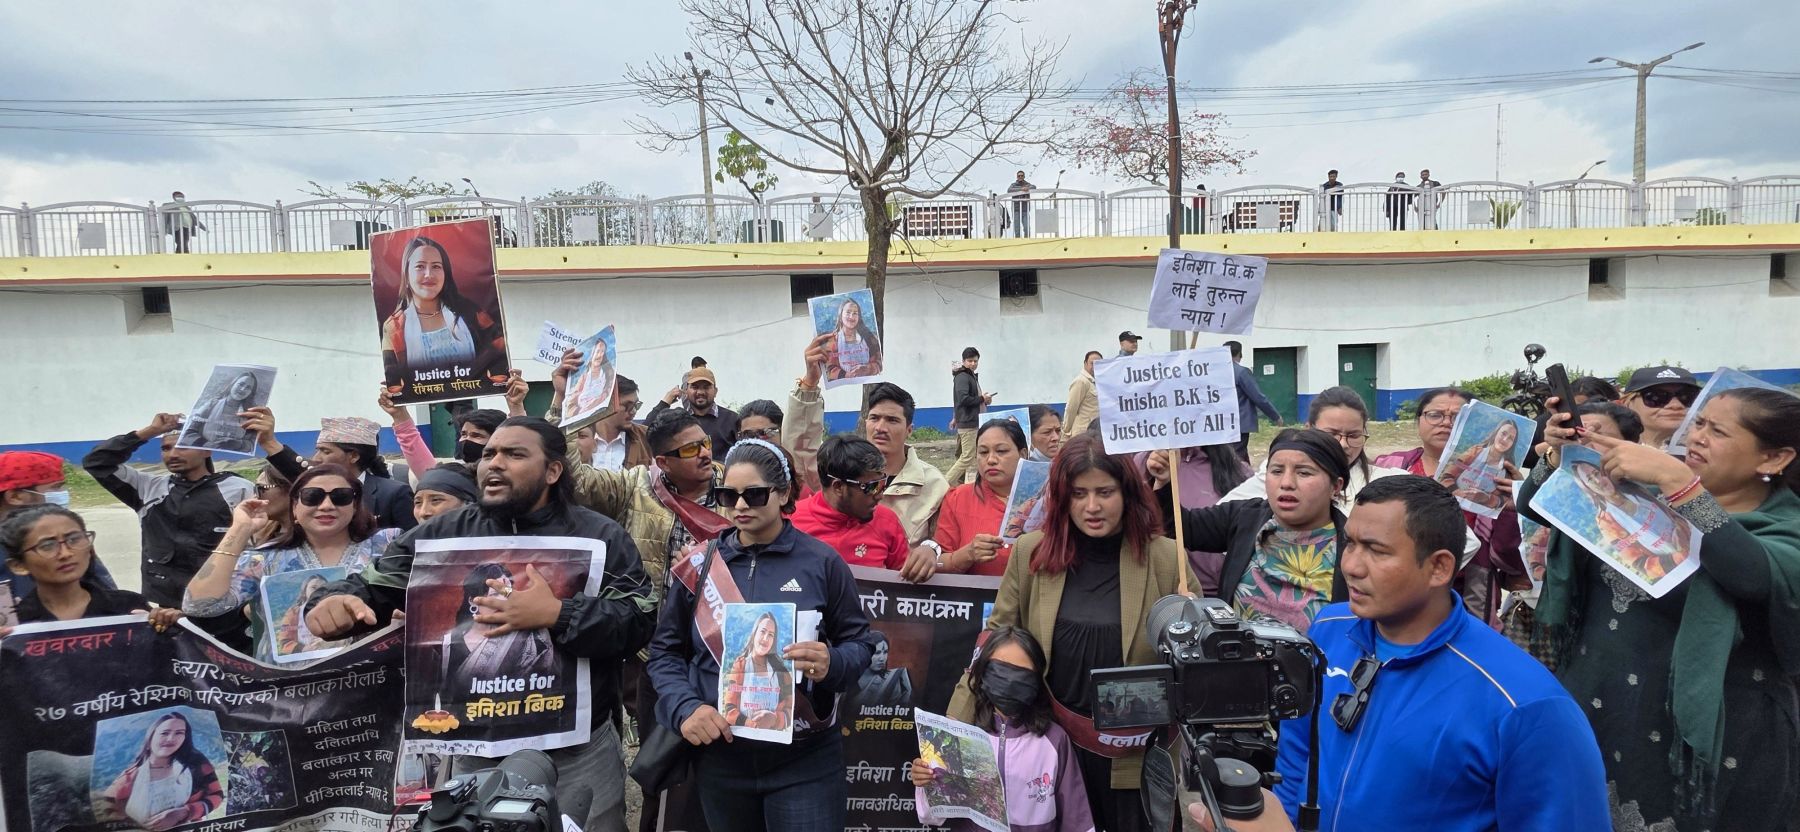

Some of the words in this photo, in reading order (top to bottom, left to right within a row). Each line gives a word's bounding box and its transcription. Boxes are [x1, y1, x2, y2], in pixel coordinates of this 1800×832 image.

[1172, 253, 1216, 276] इनिशा
[1223, 258, 1257, 280] बि.क
[1172, 279, 1200, 298] लाई
[1207, 286, 1247, 306] तुरुन्त
[1181, 309, 1215, 327] न्याय
[1220, 312, 1226, 328] !
[538, 349, 561, 365] Stop
[552, 342, 567, 353] the
[414, 368, 451, 381] Justice
[454, 365, 471, 377] for
[1123, 361, 1181, 384] Justice
[1187, 360, 1209, 376] for
[451, 379, 482, 391] परियार
[1118, 391, 1168, 412] Inisha
[1174, 387, 1202, 407] B.K
[1207, 385, 1220, 404] is
[1109, 419, 1167, 441] Justice
[1173, 417, 1196, 435] for
[1203, 413, 1224, 433] All
[1230, 412, 1235, 430] !
[859, 589, 888, 619] ारी
[896, 593, 974, 621] कार्यक्रम
[34, 707, 66, 721] २७
[72, 691, 127, 716] वर्षीय
[195, 685, 280, 706] परियारको
[284, 666, 388, 699] बलात्कारीलाई
[470, 676, 525, 694] Justice
[529, 672, 555, 690] for
[466, 699, 520, 721] इनिशा
[524, 694, 565, 716] बिक
[859, 705, 893, 716] Justice
[894, 705, 910, 716] for
[305, 720, 349, 735] महिला
[350, 714, 377, 727] तथा
[855, 718, 889, 732] इनिशा
[890, 718, 914, 731] बिक
[314, 729, 380, 750] दलितमाथि
[301, 752, 362, 771] बलात्कार
[363, 750, 373, 761] र
[374, 749, 394, 763] हत्या
[328, 768, 357, 780] अन्त्य
[359, 767, 374, 778] गर
[845, 760, 895, 784] इनिशा
[304, 781, 365, 804] पीडितलाई
[340, 810, 360, 825] गरी
[361, 815, 382, 830] हत्या
